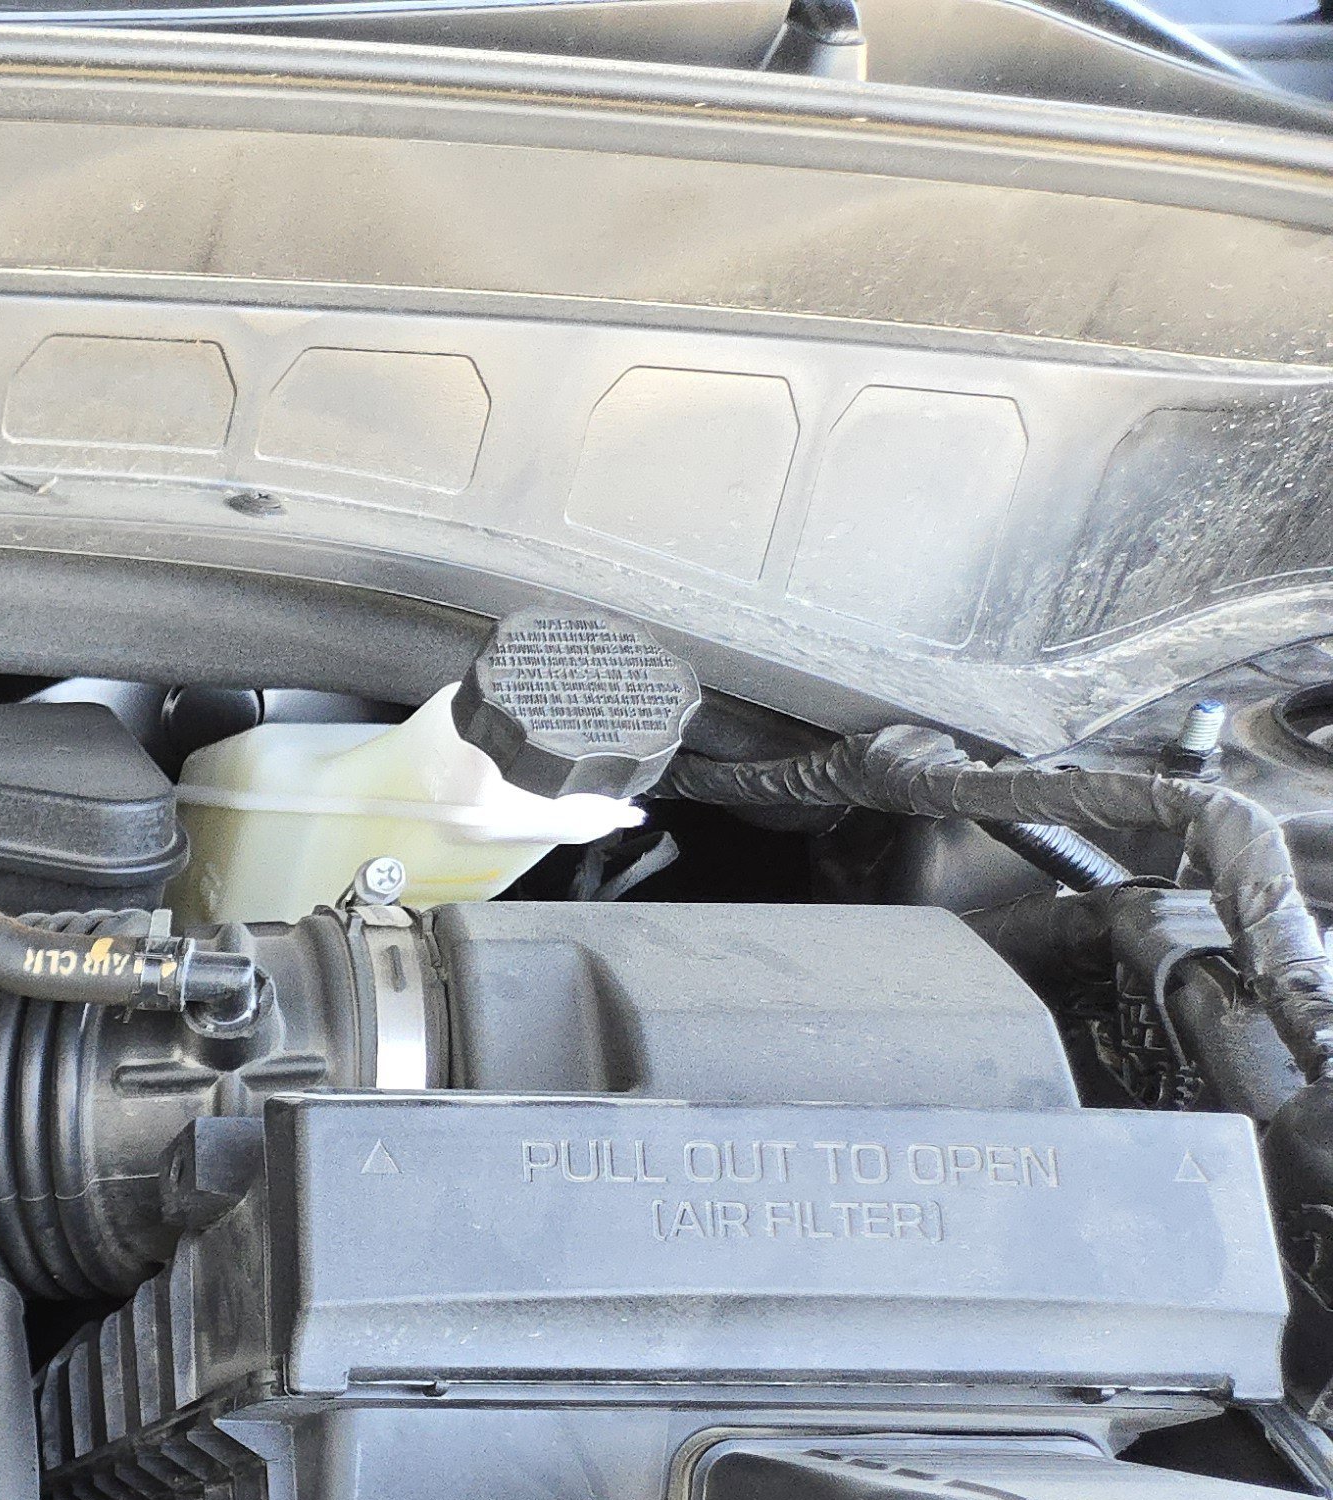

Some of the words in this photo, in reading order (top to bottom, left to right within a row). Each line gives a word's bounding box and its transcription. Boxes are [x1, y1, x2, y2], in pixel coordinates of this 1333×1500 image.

[521, 1138, 668, 1184] PULL
[683, 1139, 797, 1185] OUT
[813, 1141, 889, 1186] TO
[907, 1143, 1061, 1189] OPEN
